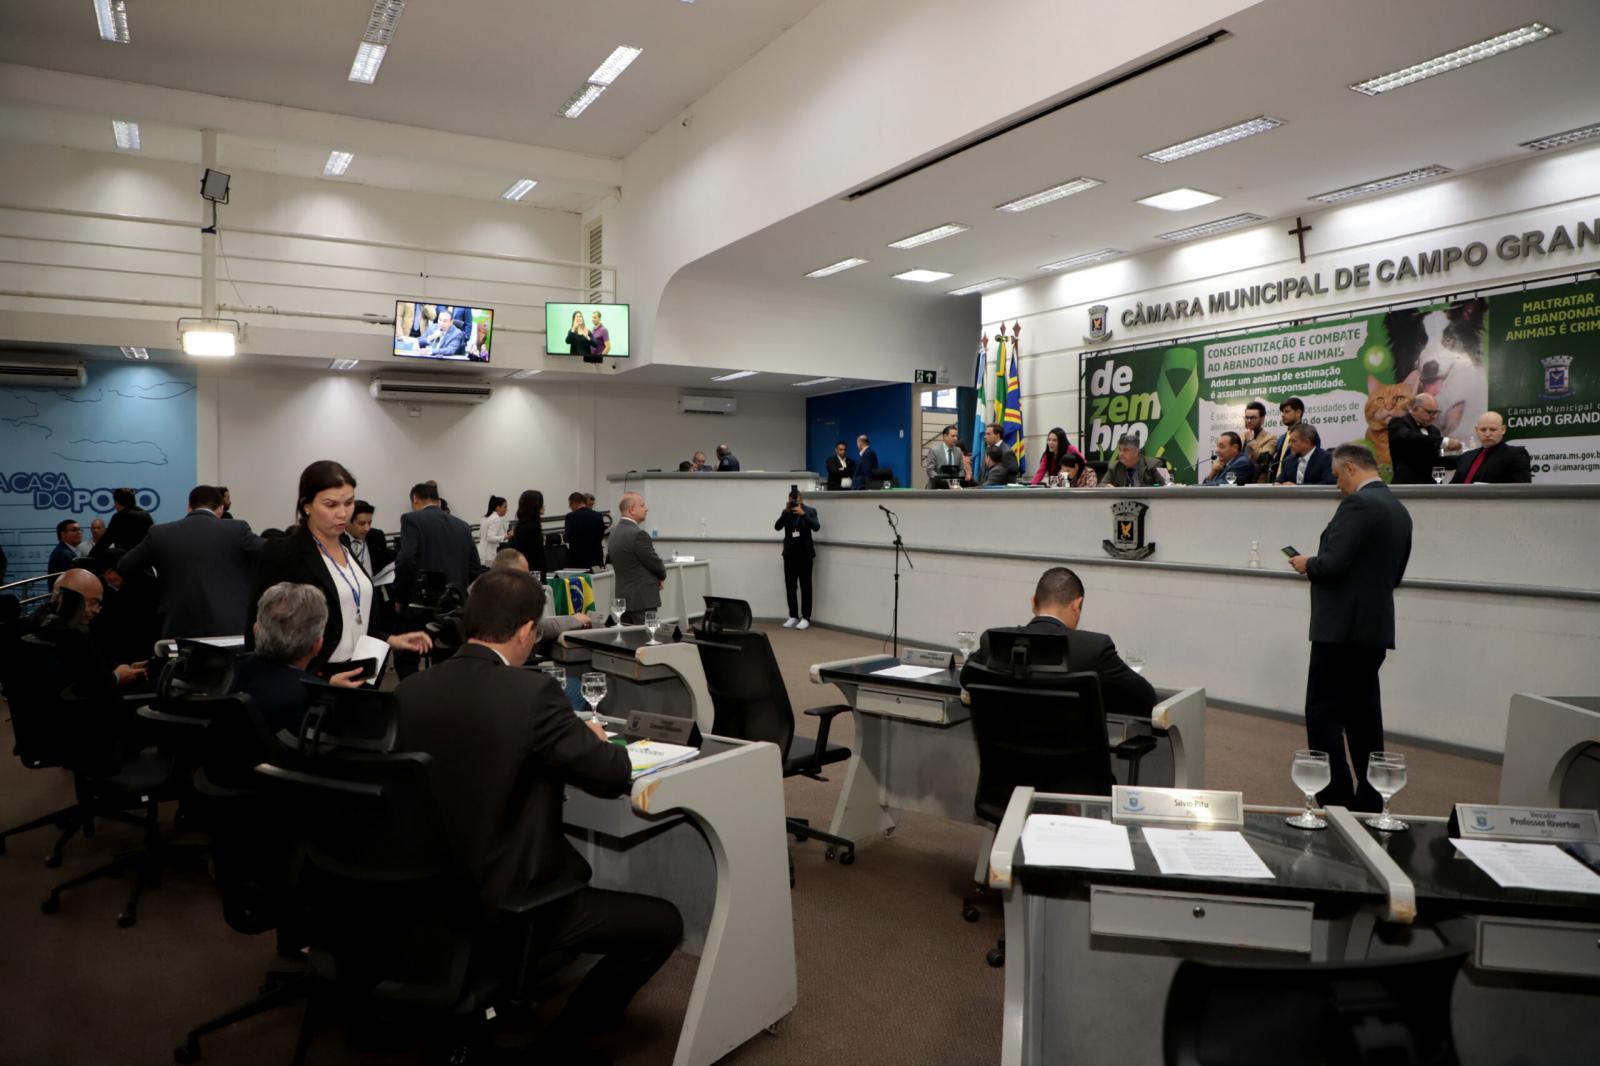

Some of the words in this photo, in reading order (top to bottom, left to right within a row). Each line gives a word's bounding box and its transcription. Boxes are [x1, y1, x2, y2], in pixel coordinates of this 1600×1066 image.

[1121, 297, 1204, 328] CÂMARA
[1208, 273, 1328, 314] MUNICIPAL
[1335, 263, 1370, 290] DE
[1376, 241, 1488, 283] CAMPO
[1497, 218, 1600, 261] GRAN
[1523, 293, 1595, 313] MALTRATAR
[1514, 316, 1521, 326] E
[1524, 305, 1600, 325] ABANDONAR
[1506, 325, 1556, 341] ANIMAIS
[1559, 322, 1567, 334] É
[1208, 336, 1296, 359] CONSCIENTIZAÇÃO
[1299, 336, 1305, 347] E
[1309, 328, 1361, 345] COMBATE
[1208, 362, 1220, 372] AO
[1223, 355, 1279, 371] ABANDONO
[1282, 352, 1295, 364] DE
[1297, 347, 1345, 361] ANIMAIS
[1090, 359, 1134, 396] de
[1210, 379, 1237, 388] Adotar
[1238, 377, 1251, 385] um
[1252, 372, 1280, 384] animal
[1281, 371, 1293, 380] de
[1294, 366, 1341, 379] estimação
[1217, 387, 1248, 398] assumir
[1249, 387, 1267, 395] uma
[1269, 378, 1347, 394] responsabilidade.
[1090, 391, 1161, 424] zem
[1303, 403, 1347, 414] cessidades
[1348, 401, 1359, 410] de
[1508, 407, 1542, 416] Câmara
[1546, 402, 1593, 413] Municipal
[1310, 415, 1320, 424] do
[1323, 416, 1339, 424] seu
[1340, 414, 1358, 424] pet.
[1508, 415, 1551, 428] CAMPO
[1555, 412, 1600, 425] GRAND
[1090, 418, 1149, 453] bro
[11, 473, 71, 492] CASA
[36, 491, 72, 508] DO
[73, 490, 158, 513] POO
[1510, 817, 1545, 826] Professor
